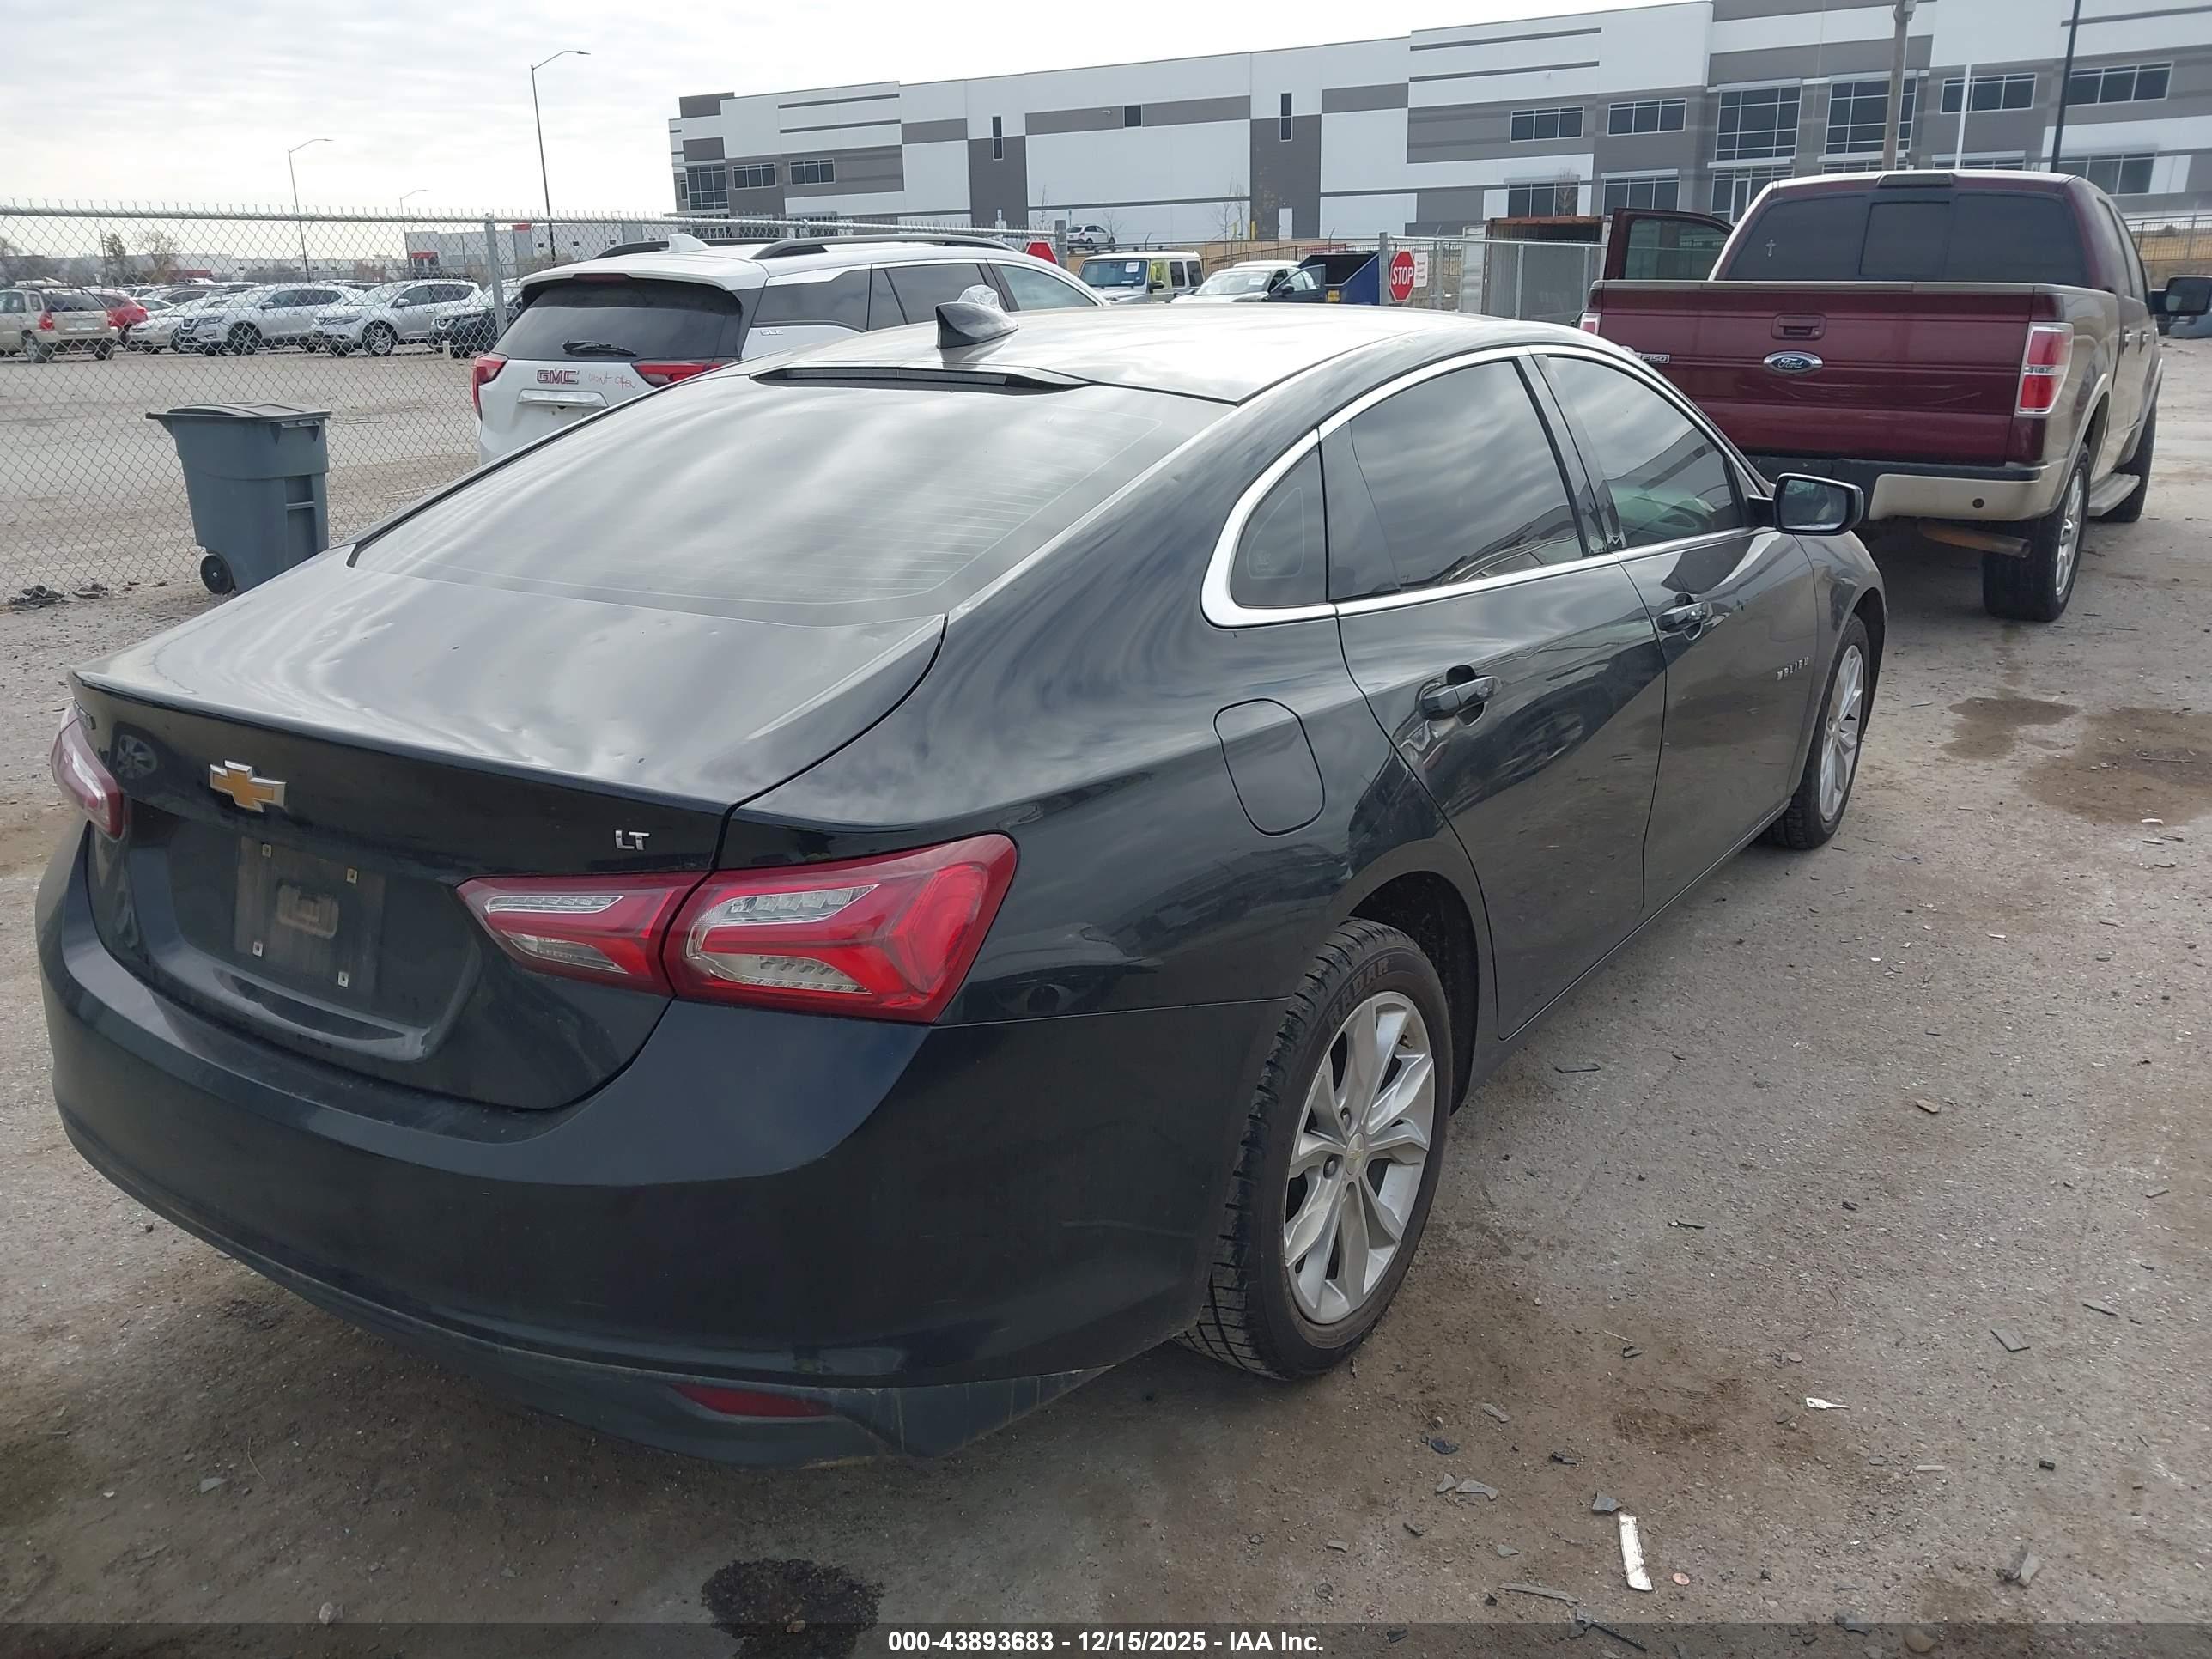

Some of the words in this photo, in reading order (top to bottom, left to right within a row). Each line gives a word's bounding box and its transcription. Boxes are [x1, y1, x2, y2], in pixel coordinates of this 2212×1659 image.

[1392, 266, 1413, 285] STOP
[1778, 357, 1804, 368] Ford
[537, 369, 580, 385] GMC
[1777, 656, 1809, 680] MALIBU
[615, 830, 650, 851] LT
